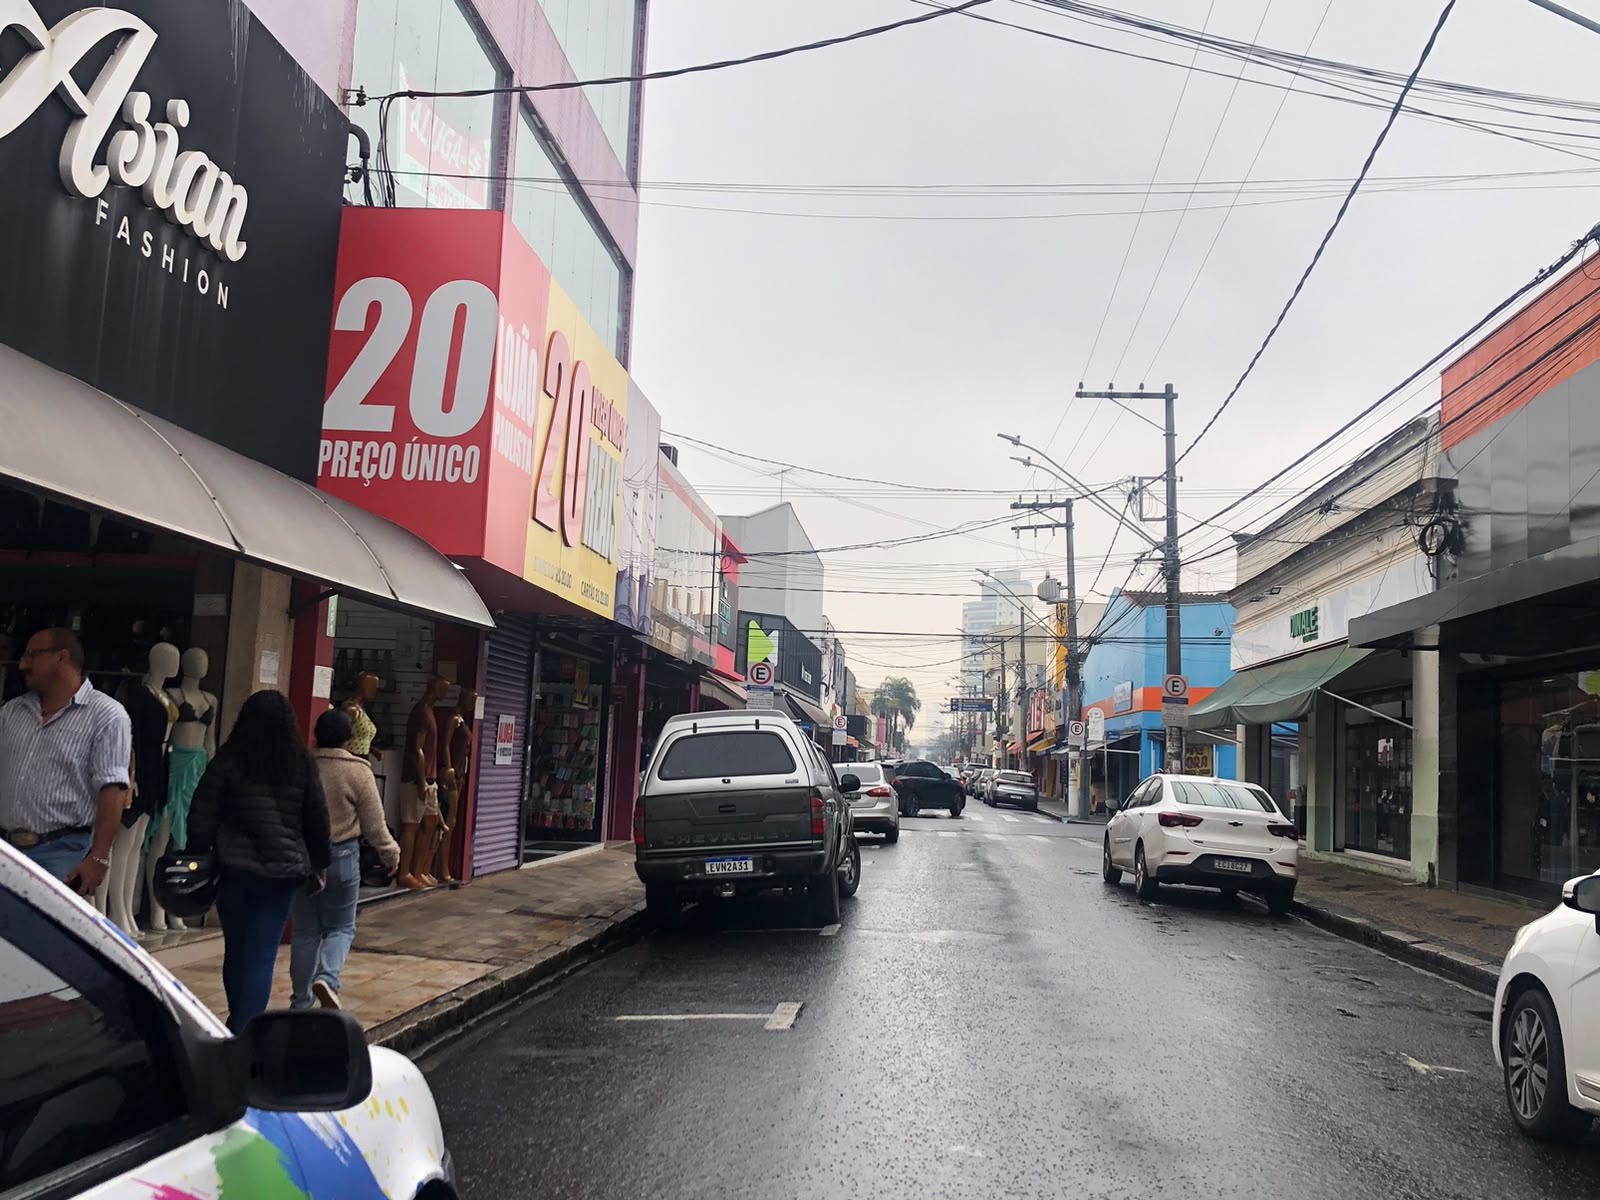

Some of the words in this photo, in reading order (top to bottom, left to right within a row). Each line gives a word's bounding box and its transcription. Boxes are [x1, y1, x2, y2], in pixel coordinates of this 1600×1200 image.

[0, 0, 248, 262] Asian
[95, 198, 229, 309] FASHION
[322, 276, 499, 438] 20
[495, 315, 538, 428] LOJÃO
[317, 439, 397, 487] PREÇO
[401, 436, 481, 484] ÚNICO
[493, 411, 533, 475] PAULISTA
[532, 330, 593, 548] 20
[756, 667, 766, 680] E
[1172, 680, 1180, 693] E
[1074, 725, 1080, 733] E
[710, 861, 749, 873] EVN2A31
